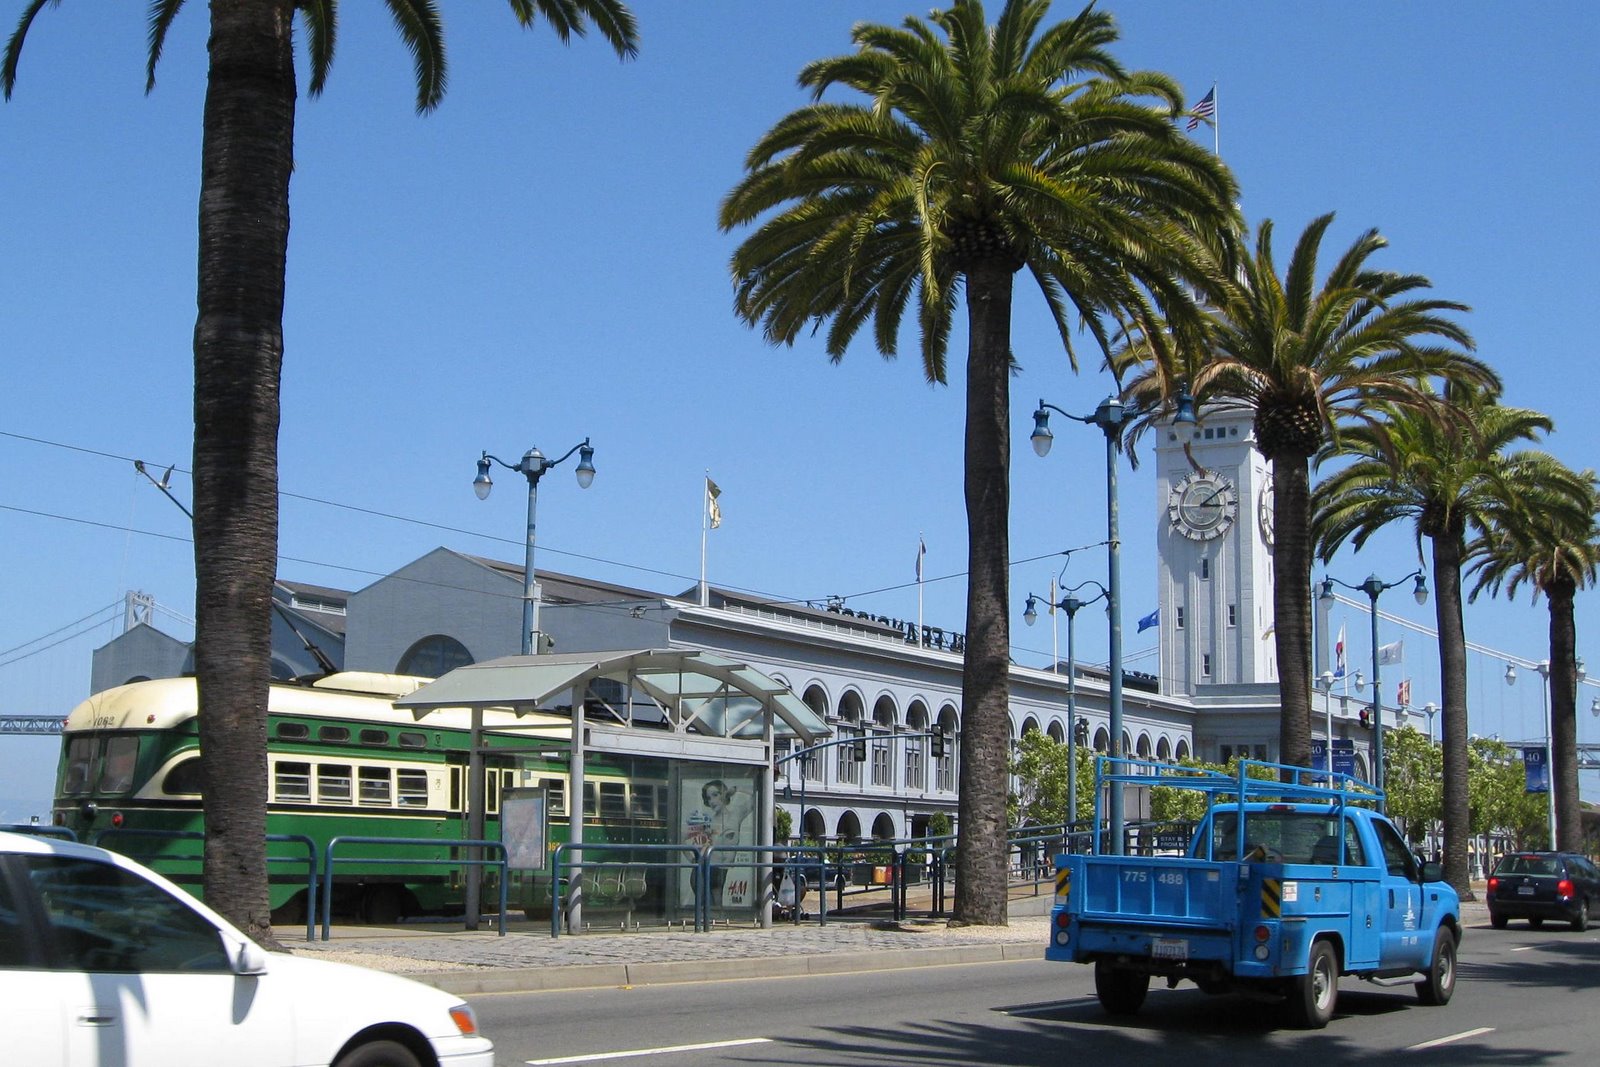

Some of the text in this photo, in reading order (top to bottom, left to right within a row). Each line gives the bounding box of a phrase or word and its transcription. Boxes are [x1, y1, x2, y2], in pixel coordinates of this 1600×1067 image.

[1526, 752, 1540, 761] 40
[1124, 871, 1184, 885] 775 488
